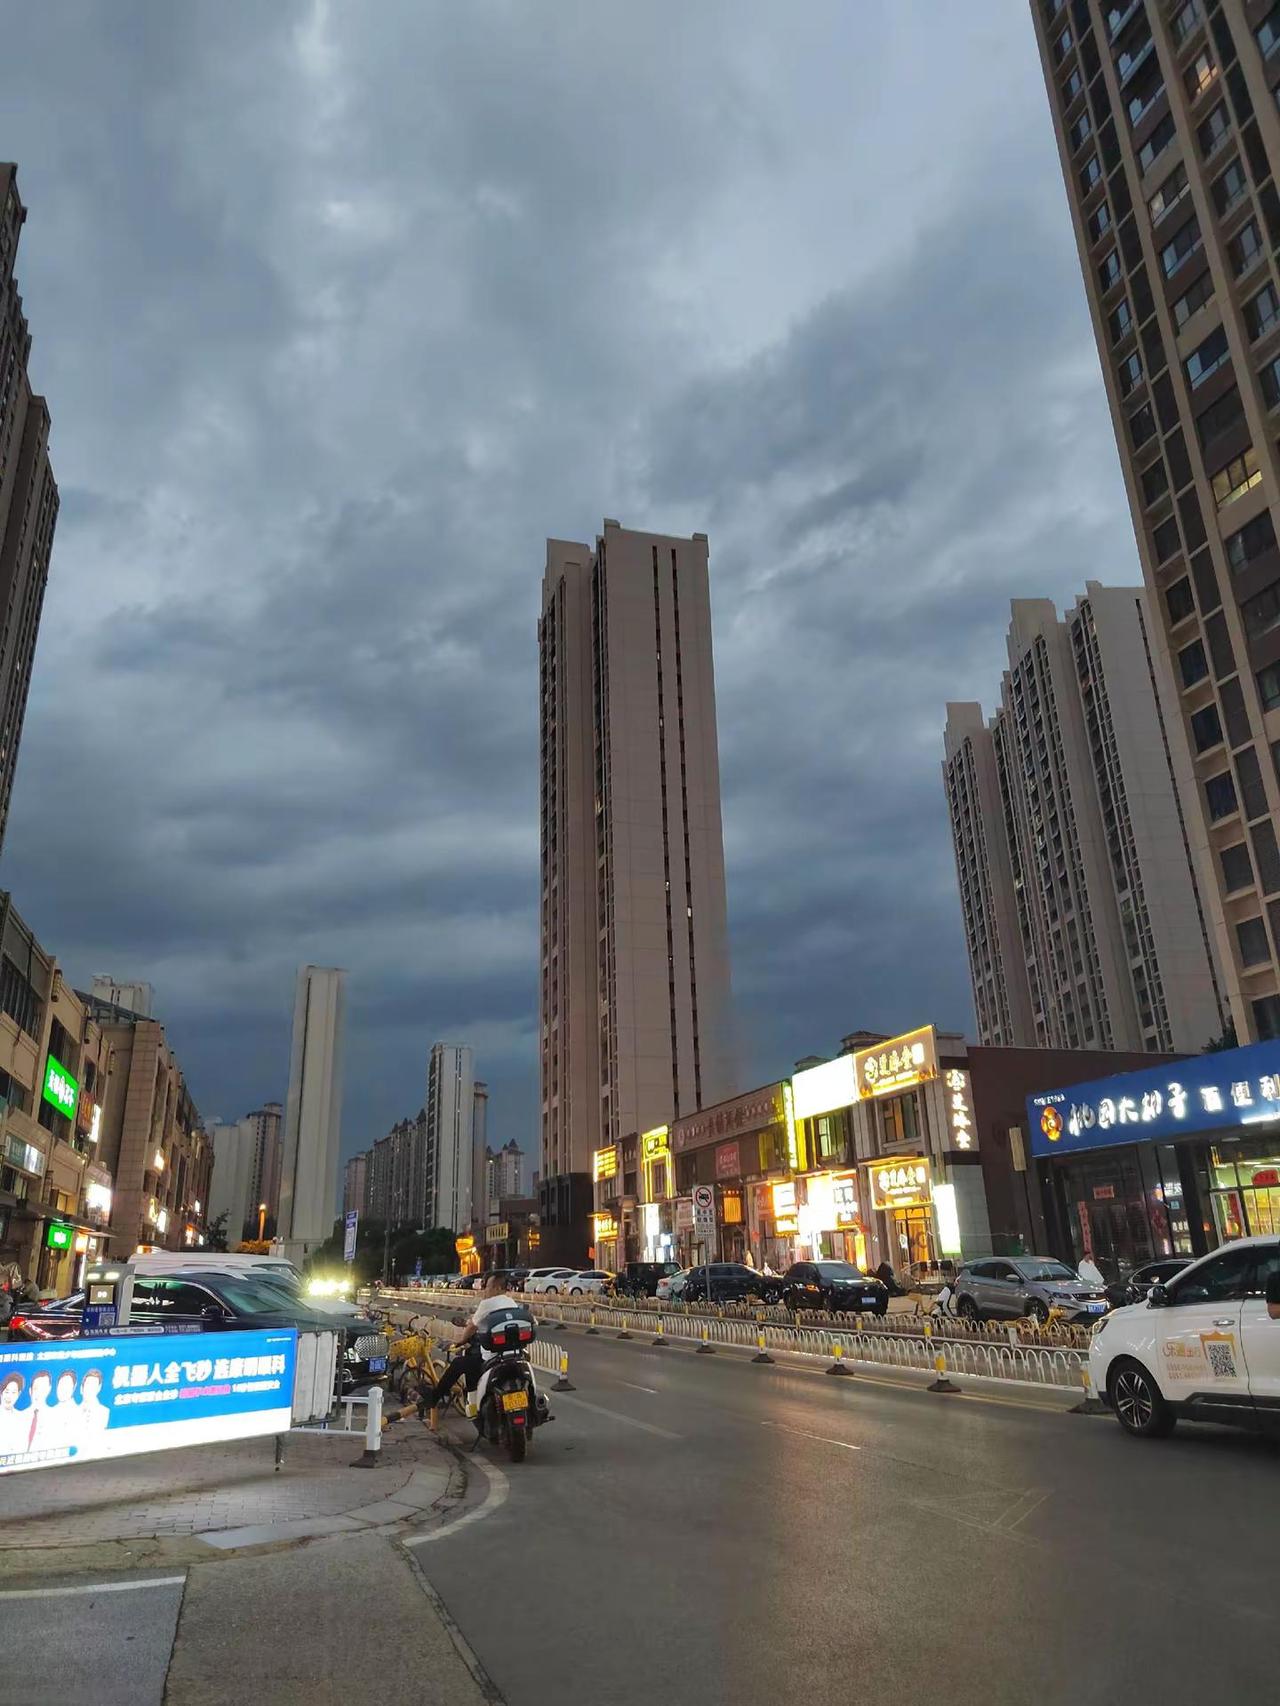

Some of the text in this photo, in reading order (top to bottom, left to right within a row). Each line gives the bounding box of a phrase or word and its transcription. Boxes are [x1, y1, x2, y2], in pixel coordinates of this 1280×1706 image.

[113, 1359, 212, 1389] 机器人全飞秒
